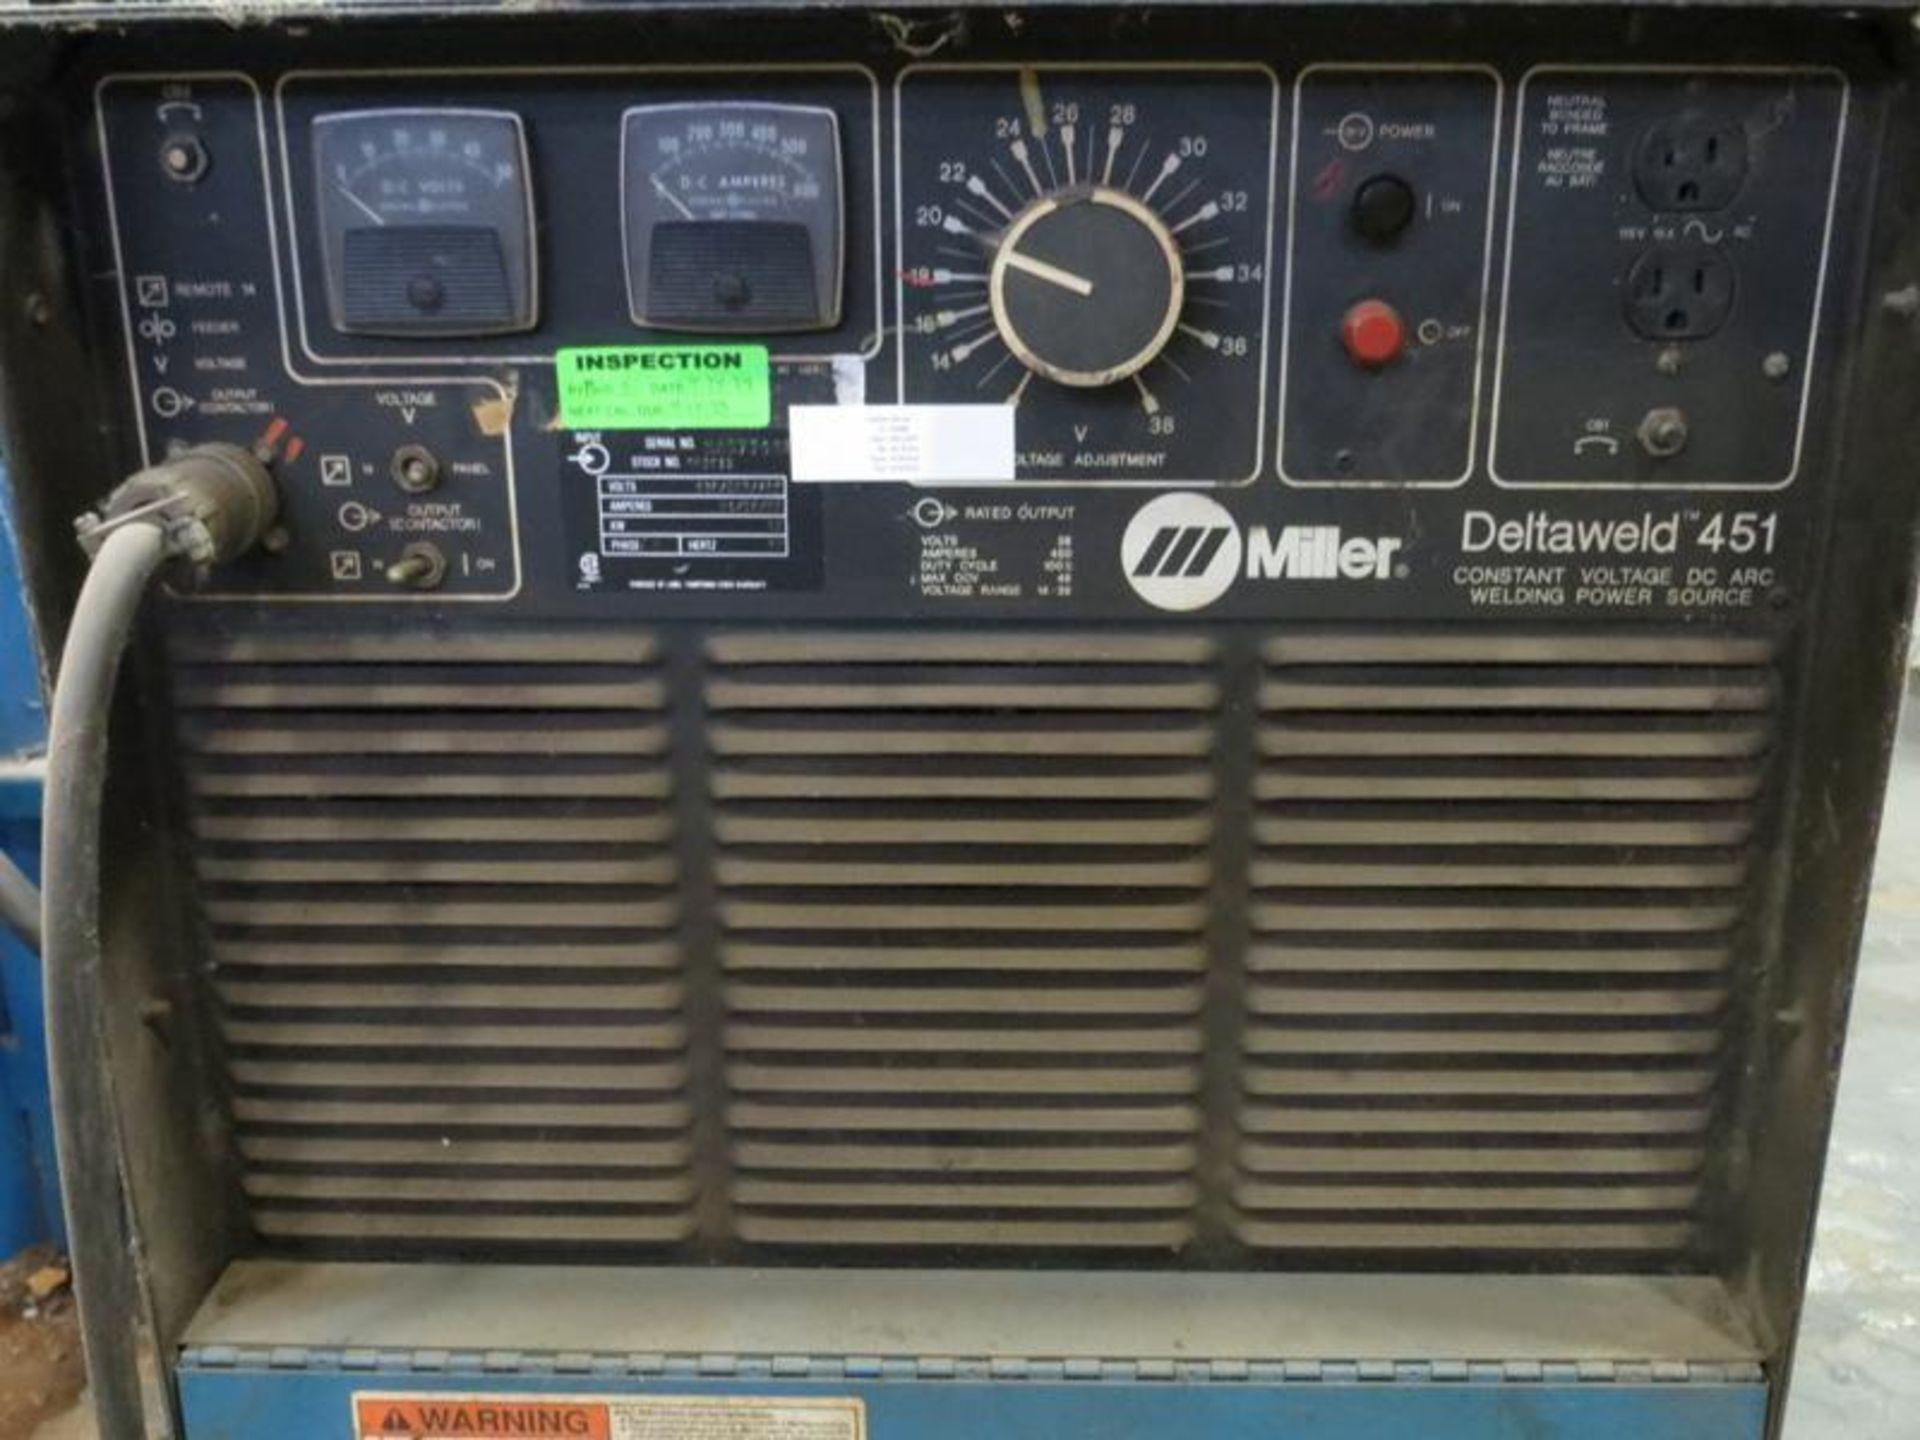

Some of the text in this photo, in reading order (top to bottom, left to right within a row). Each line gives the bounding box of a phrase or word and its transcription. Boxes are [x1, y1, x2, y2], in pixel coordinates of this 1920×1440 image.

[1053, 103, 1078, 123] 26
[1110, 104, 1135, 125] 28
[996, 117, 1020, 137] 24
[1379, 124, 1436, 138] POWER
[1541, 122, 1607, 135] TO FRAME
[1180, 137, 1206, 157] 30
[939, 162, 965, 182] 22
[1221, 192, 1247, 211] 32
[1441, 201, 1461, 213] ON
[916, 207, 942, 225] 20
[1237, 264, 1263, 282] 34
[175, 282, 232, 297] REMOTE
[914, 315, 935, 333] 16
[1222, 336, 1247, 355] 36
[153, 356, 168, 373] V
[194, 357, 246, 370] VOLTAGE
[576, 352, 742, 371] INSPECTION
[932, 352, 950, 370] 14
[211, 388, 257, 400] OUTPUT
[376, 391, 436, 407] VOLTAGE
[402, 408, 415, 424] V
[1149, 416, 1174, 434] 38
[1074, 426, 1087, 442] V
[1074, 453, 1167, 467] ADJUSTMENT
[453, 463, 489, 475] PANEL
[608, 481, 637, 493] VOLTS
[407, 503, 461, 517] OUTPUT
[964, 503, 1075, 519] RATED OUTPUT
[921, 534, 958, 546] VOLTS
[1461, 511, 1679, 553] Deltaweld
[1697, 512, 1778, 553] 451
[921, 548, 977, 559] AMPERES
[1246, 527, 1399, 579] Miller
[475, 557, 495, 570] ON
[921, 560, 951, 572] DUTY
[959, 560, 998, 572] CYCLE
[921, 573, 946, 583] MAX
[1453, 566, 1775, 586] CONSTANT VOLTAGE DC ARC
[921, 584, 974, 596] VOLTAGE
[980, 585, 1021, 596] RANGE
[1469, 588, 1753, 606] WELDING POWER SOURCE
[418, 1408, 589, 1434] WARNING
